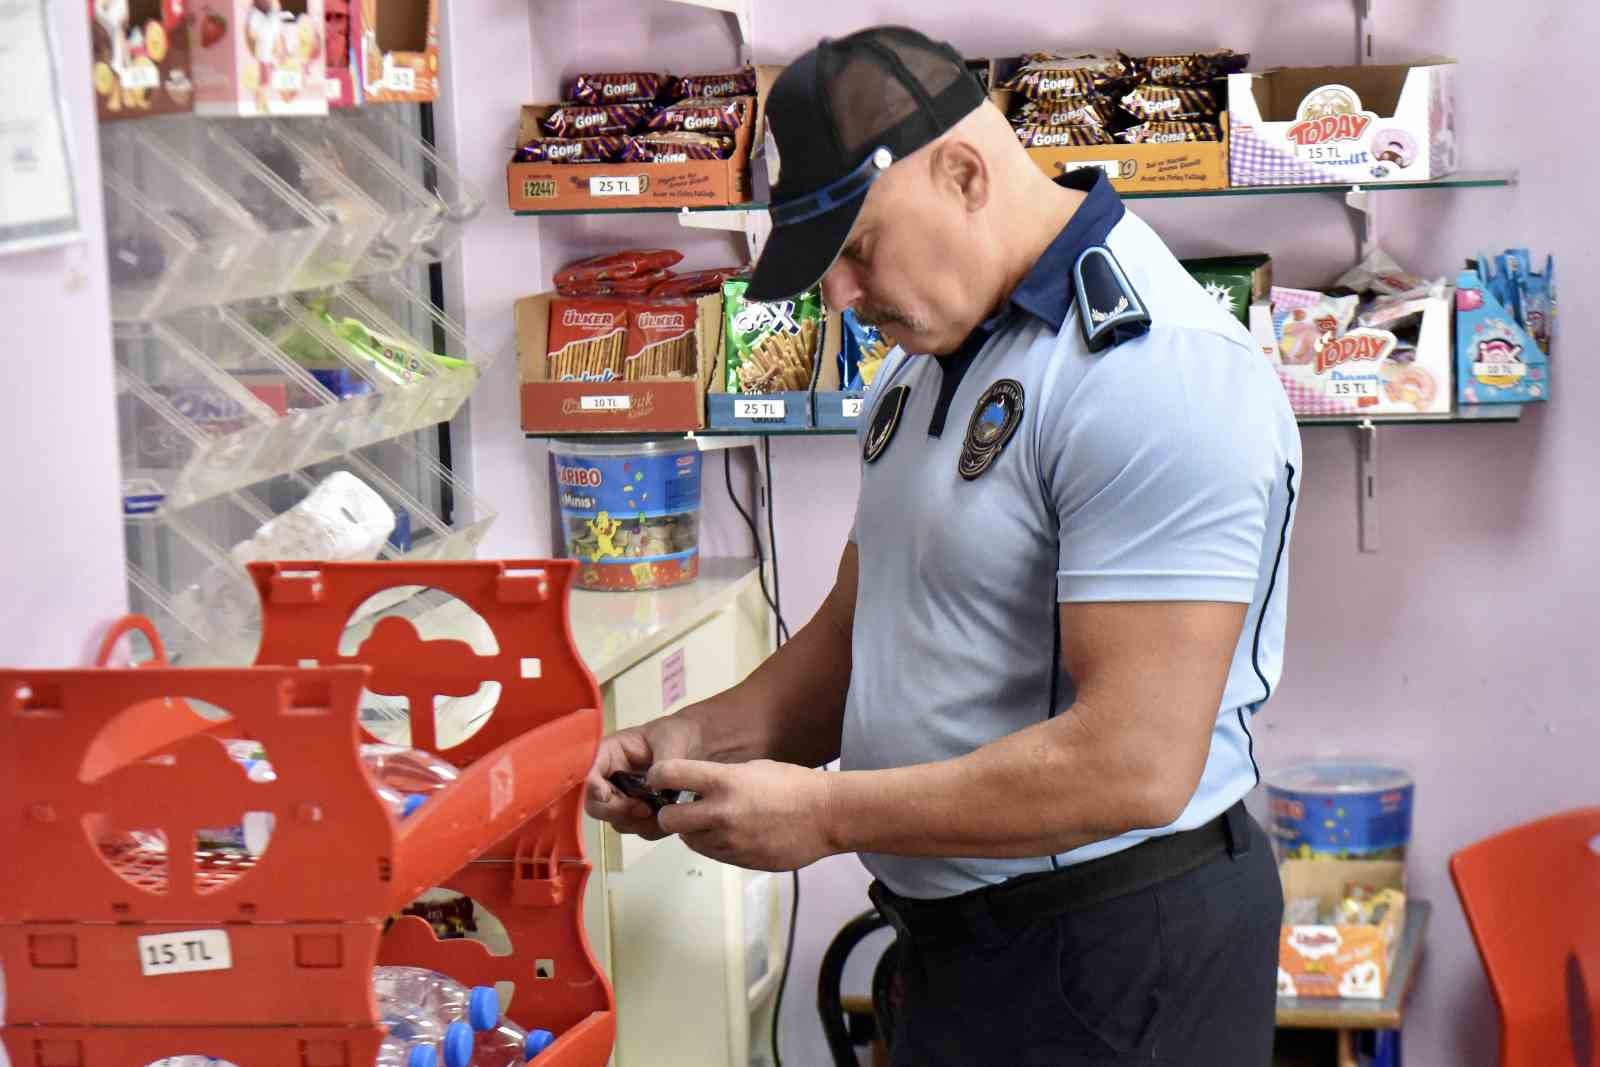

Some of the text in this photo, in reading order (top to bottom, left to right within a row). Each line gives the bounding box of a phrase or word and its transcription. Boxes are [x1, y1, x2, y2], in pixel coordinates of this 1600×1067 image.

[603, 81, 637, 97] Gong
[703, 79, 735, 97] Gong
[1039, 77, 1074, 91] Gong
[1146, 98, 1181, 113] Gong
[575, 110, 608, 129] Gong
[684, 115, 719, 129] Gong
[1051, 108, 1085, 126] Gong
[1287, 113, 1370, 145] TODAY
[1033, 131, 1070, 146] Gong
[549, 142, 582, 158] Gong
[1308, 147, 1342, 159] 15 TL
[599, 180, 614, 192] 25
[617, 180, 631, 192] TL
[562, 308, 614, 327] ÜLKER
[638, 311, 684, 329] ÜLKER
[1335, 383, 1368, 394] 15 TL
[594, 398, 618, 408] 10 TL
[743, 403, 776, 414] 25 TL
[851, 402, 859, 414] 2
[147, 940, 213, 966] 15 TL
